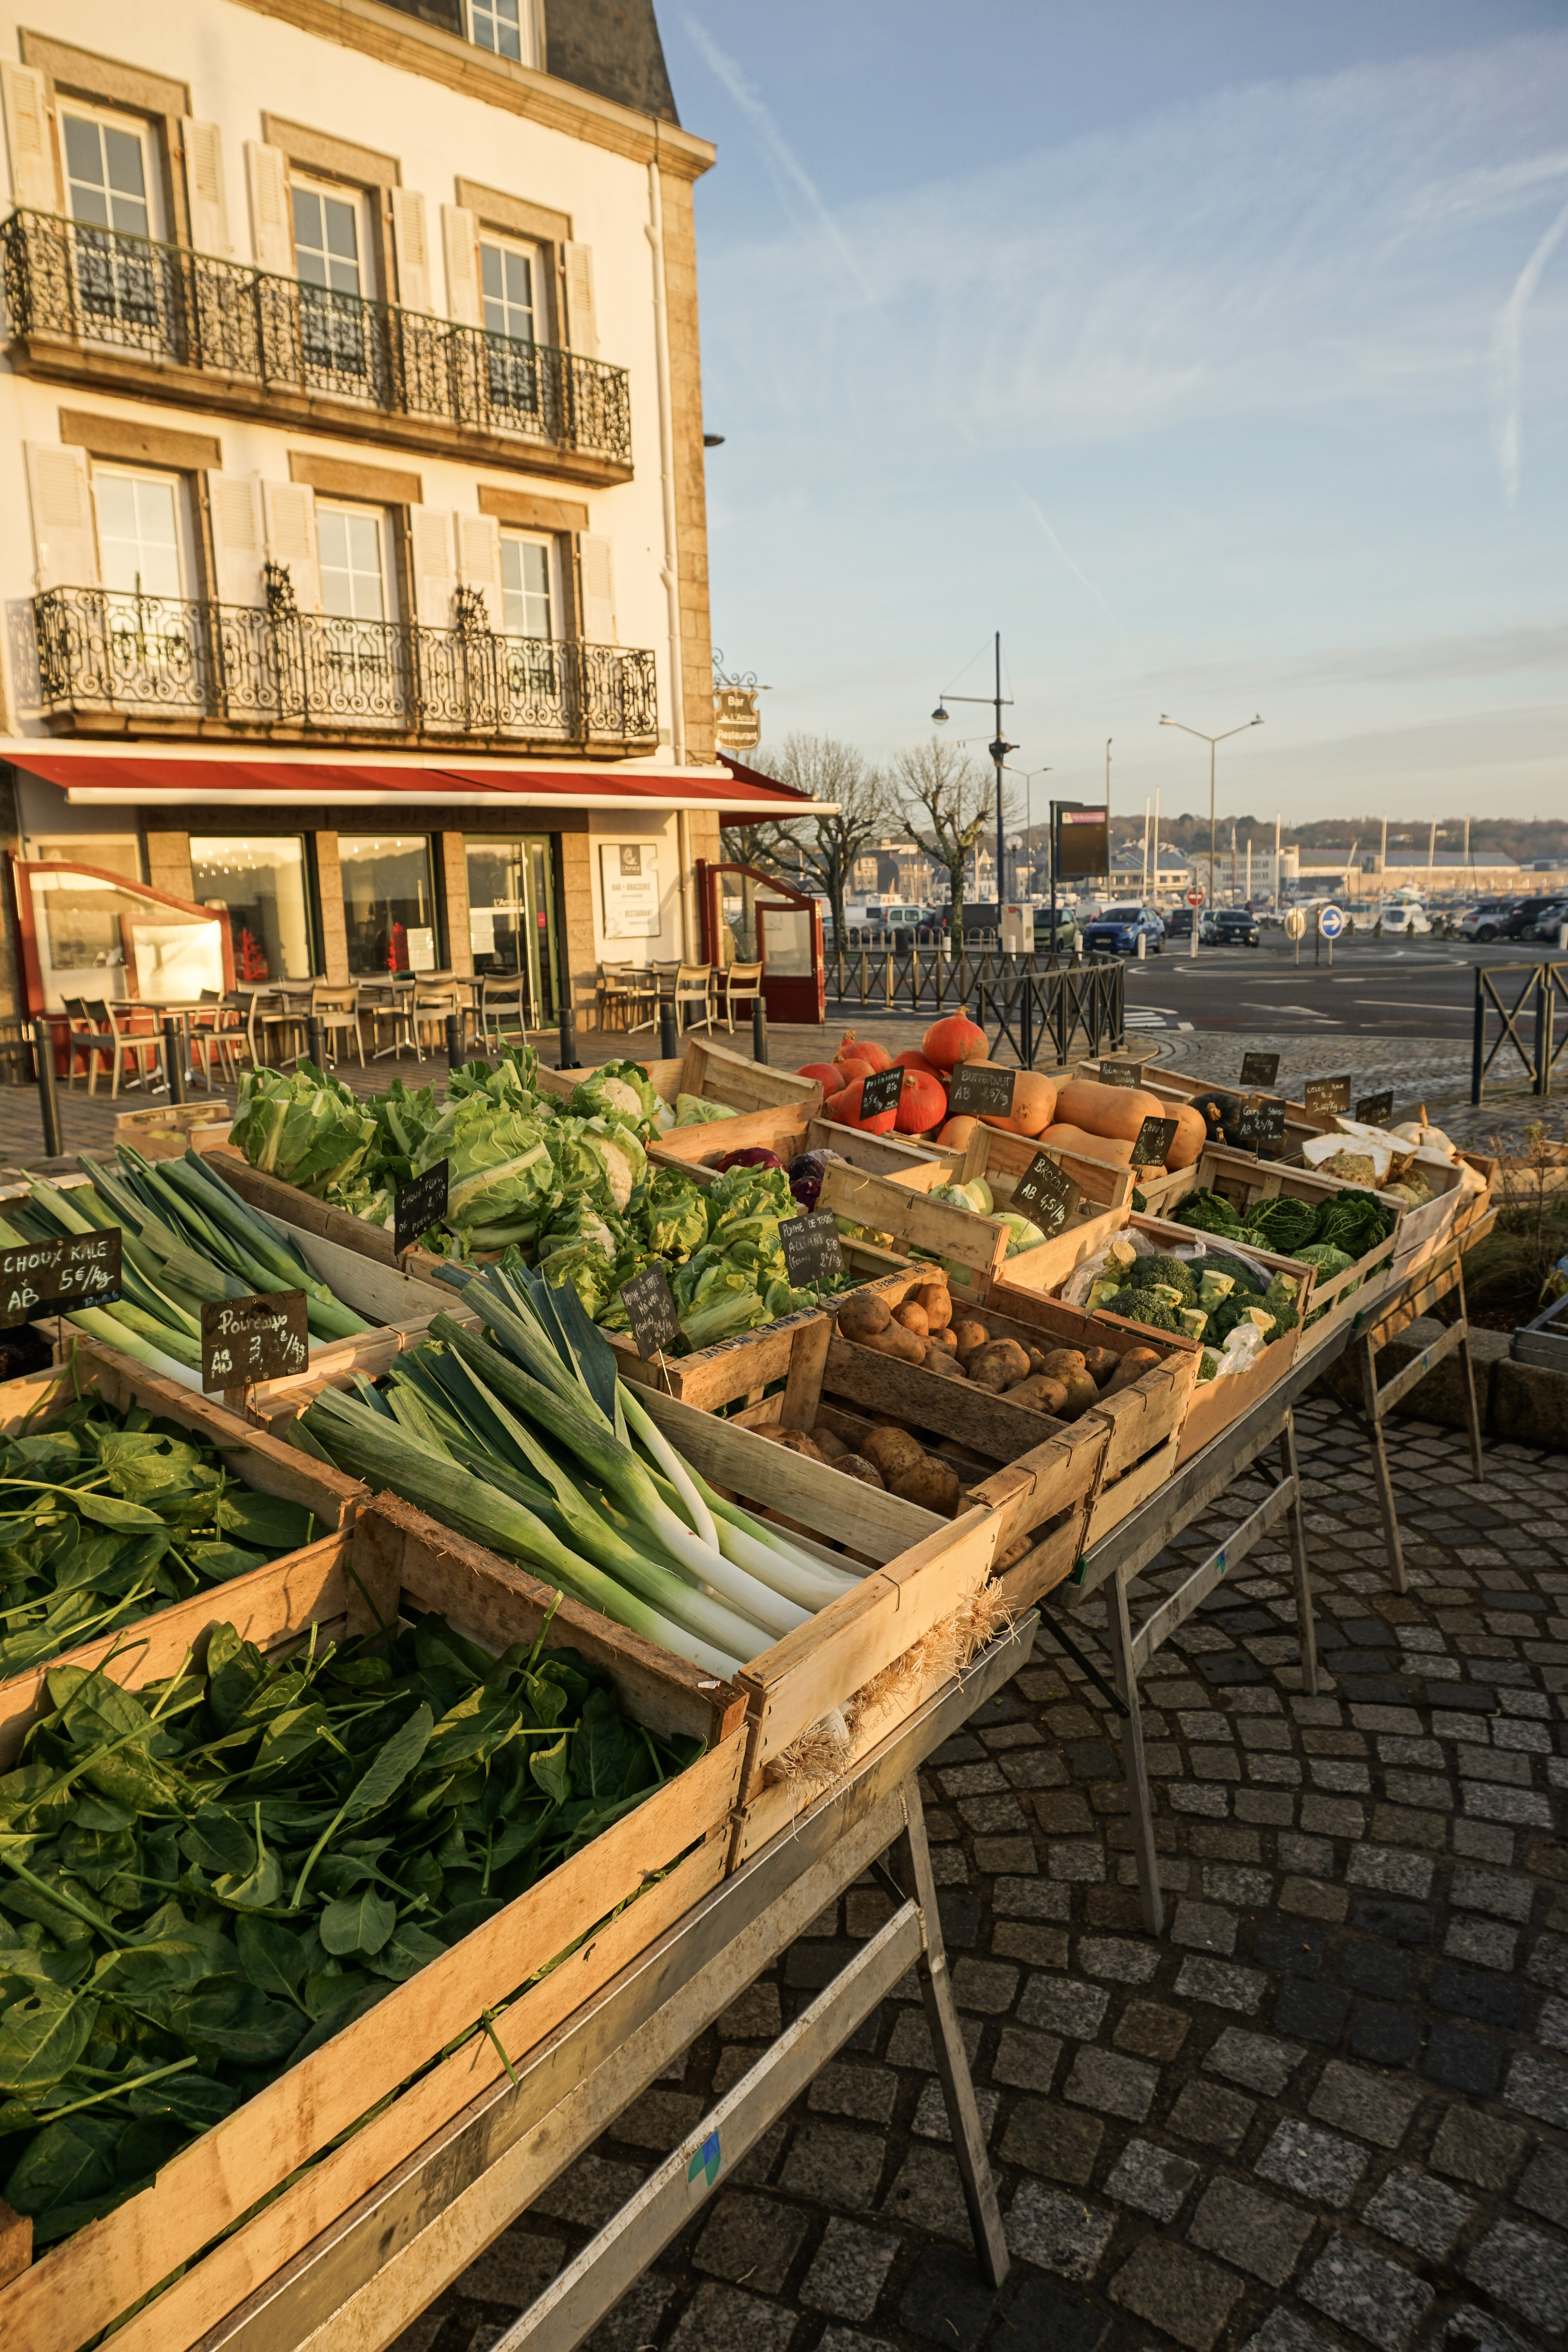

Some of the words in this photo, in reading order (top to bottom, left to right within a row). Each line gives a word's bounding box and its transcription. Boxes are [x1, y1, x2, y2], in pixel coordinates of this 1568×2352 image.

[728, 696, 744, 706] Bar
[717, 729, 757, 740] Restaurant
[625, 909, 653, 917] RESTAURANT
[961, 1070, 1013, 1087] BUTTERNUT
[955, 1086, 971, 1100] AB
[1143, 1123, 1164, 1134] CHOUX
[1034, 1158, 1069, 1196] BROCOLI
[1021, 1183, 1037, 1200] AB
[783, 1222, 804, 1237] POMME
[808, 1219, 816, 1228] DE
[817, 1212, 833, 1225] TERRE
[4, 1248, 63, 1273] CHOUX
[71, 1241, 108, 1261] KALE
[7, 1288, 39, 1312] AB
[59, 1265, 114, 1292] 5€/kg
[623, 1289, 640, 1306] POMME
[640, 1284, 647, 1294] DE
[218, 1309, 288, 1335] Poireaux
[211, 1349, 233, 1379] AB
